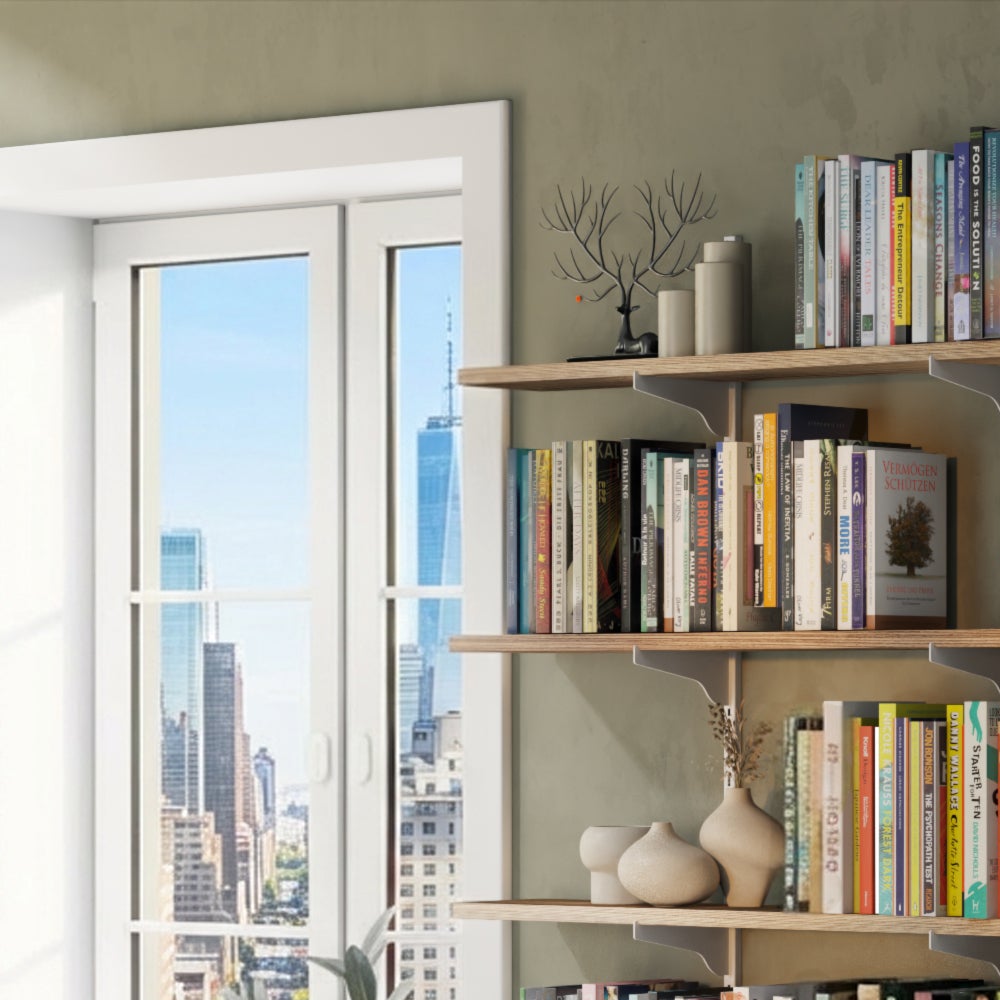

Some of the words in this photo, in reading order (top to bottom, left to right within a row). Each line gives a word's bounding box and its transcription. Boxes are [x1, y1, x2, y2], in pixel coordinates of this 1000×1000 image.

[972, 189, 980, 197] IS
[697, 470, 708, 496] DAN
[784, 494, 790, 505] OF
[823, 480, 831, 516] STEPHEN
[697, 501, 708, 547] BROWN
[840, 516, 849, 555] MORE
[697, 552, 708, 604] INFERNO
[924, 727, 933, 742] JON
[950, 712, 958, 750] DANNY
[924, 743, 933, 784] RONSON
[950, 755, 958, 810] WALLACE
[970, 745, 982, 789] STARTER
[971, 798, 980, 819] TEN
